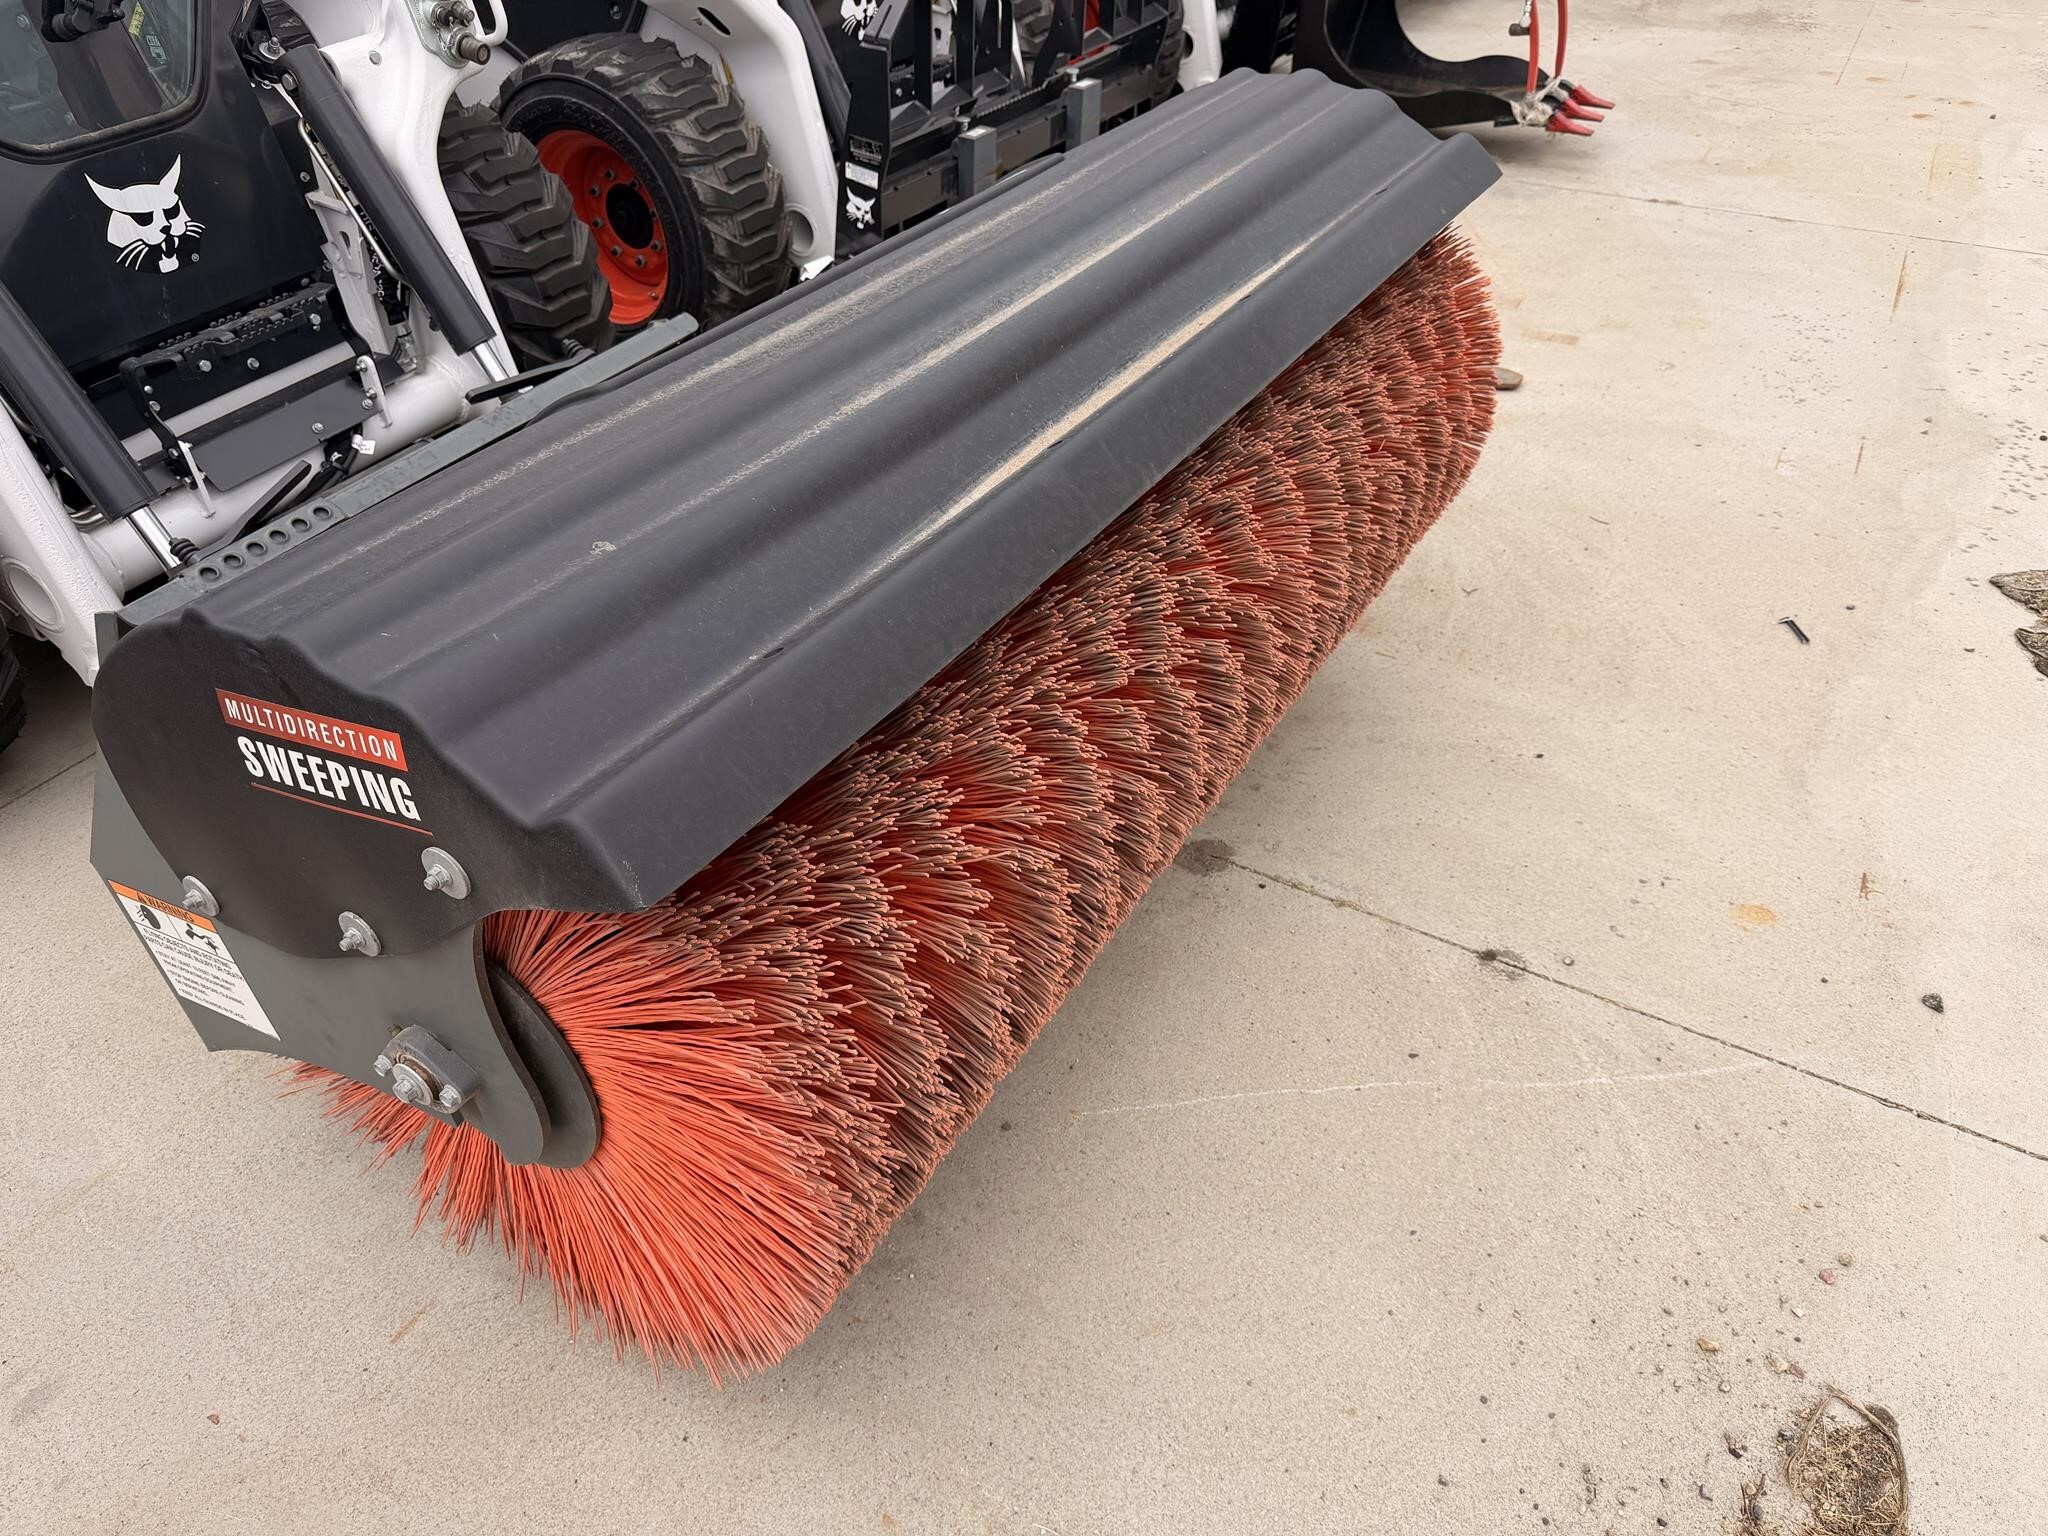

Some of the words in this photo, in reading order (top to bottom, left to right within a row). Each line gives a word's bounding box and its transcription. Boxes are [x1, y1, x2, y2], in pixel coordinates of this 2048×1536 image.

[224, 697, 398, 762] MULTIDIRECTION
[236, 735, 422, 822] SWEEPING
[145, 896, 194, 923] WARNING
